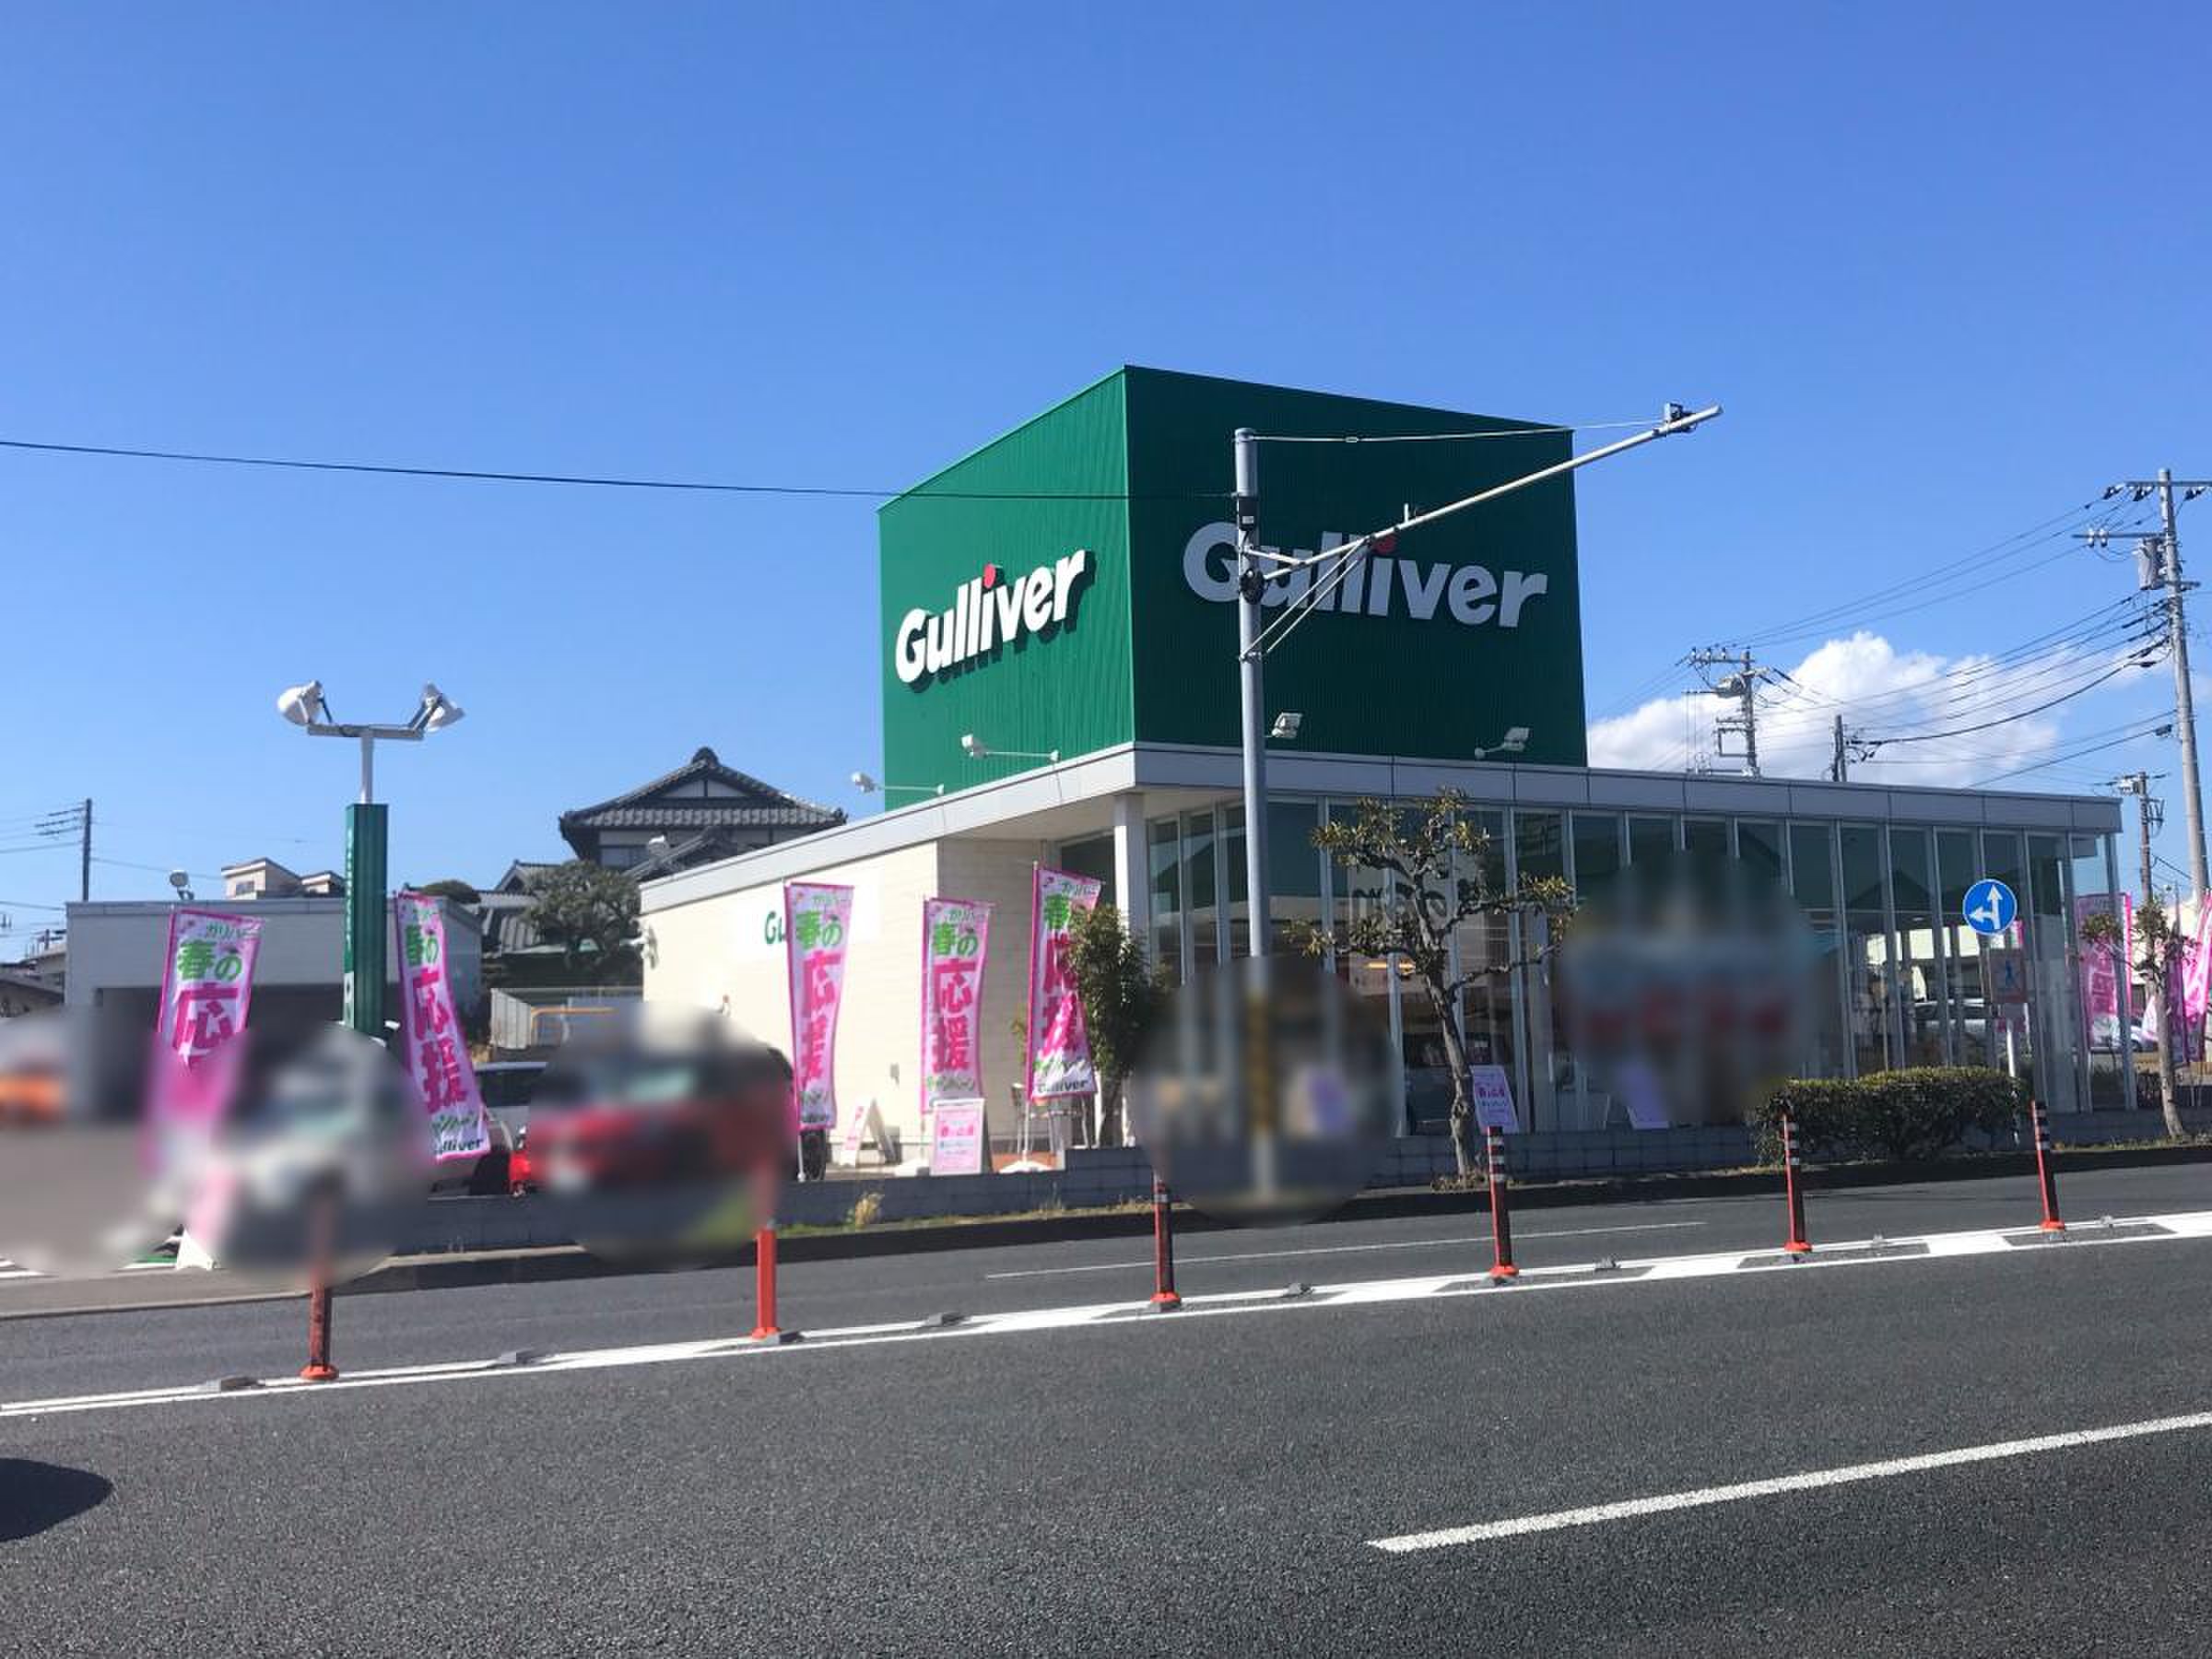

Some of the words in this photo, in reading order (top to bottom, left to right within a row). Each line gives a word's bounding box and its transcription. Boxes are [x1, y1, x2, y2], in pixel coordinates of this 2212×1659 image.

[1182, 521, 1549, 629] Gulliver
[895, 548, 1087, 683] Gulliver
[177, 938, 243, 981] 春の
[933, 922, 979, 956] 春の
